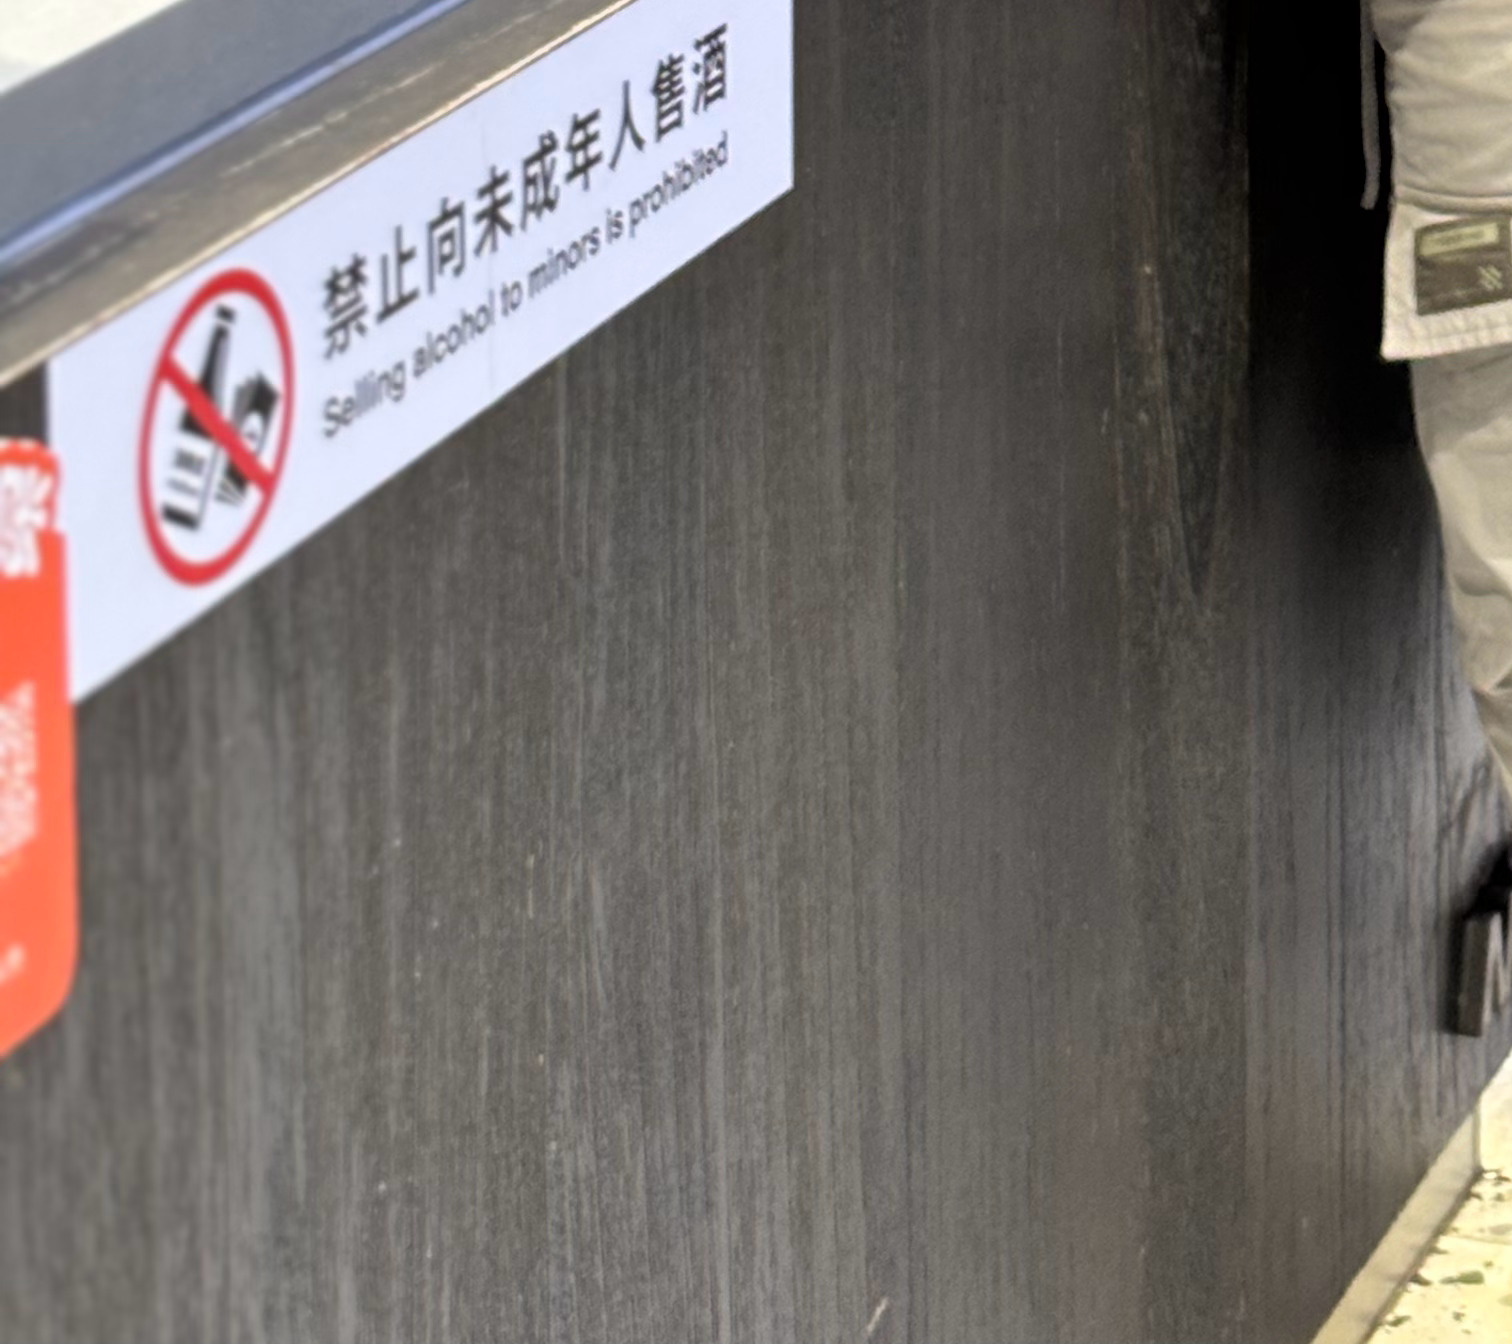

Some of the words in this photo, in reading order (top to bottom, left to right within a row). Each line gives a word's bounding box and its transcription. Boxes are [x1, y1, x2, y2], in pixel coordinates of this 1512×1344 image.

[321, 358, 407, 439] Selling
[412, 288, 496, 379] alcohol
[499, 279, 524, 320] to
[527, 225, 601, 300] minors
[605, 207, 624, 244] is
[628, 129, 729, 238] prohibited
[322, 22, 729, 360] 禁止向未成年人售酒
